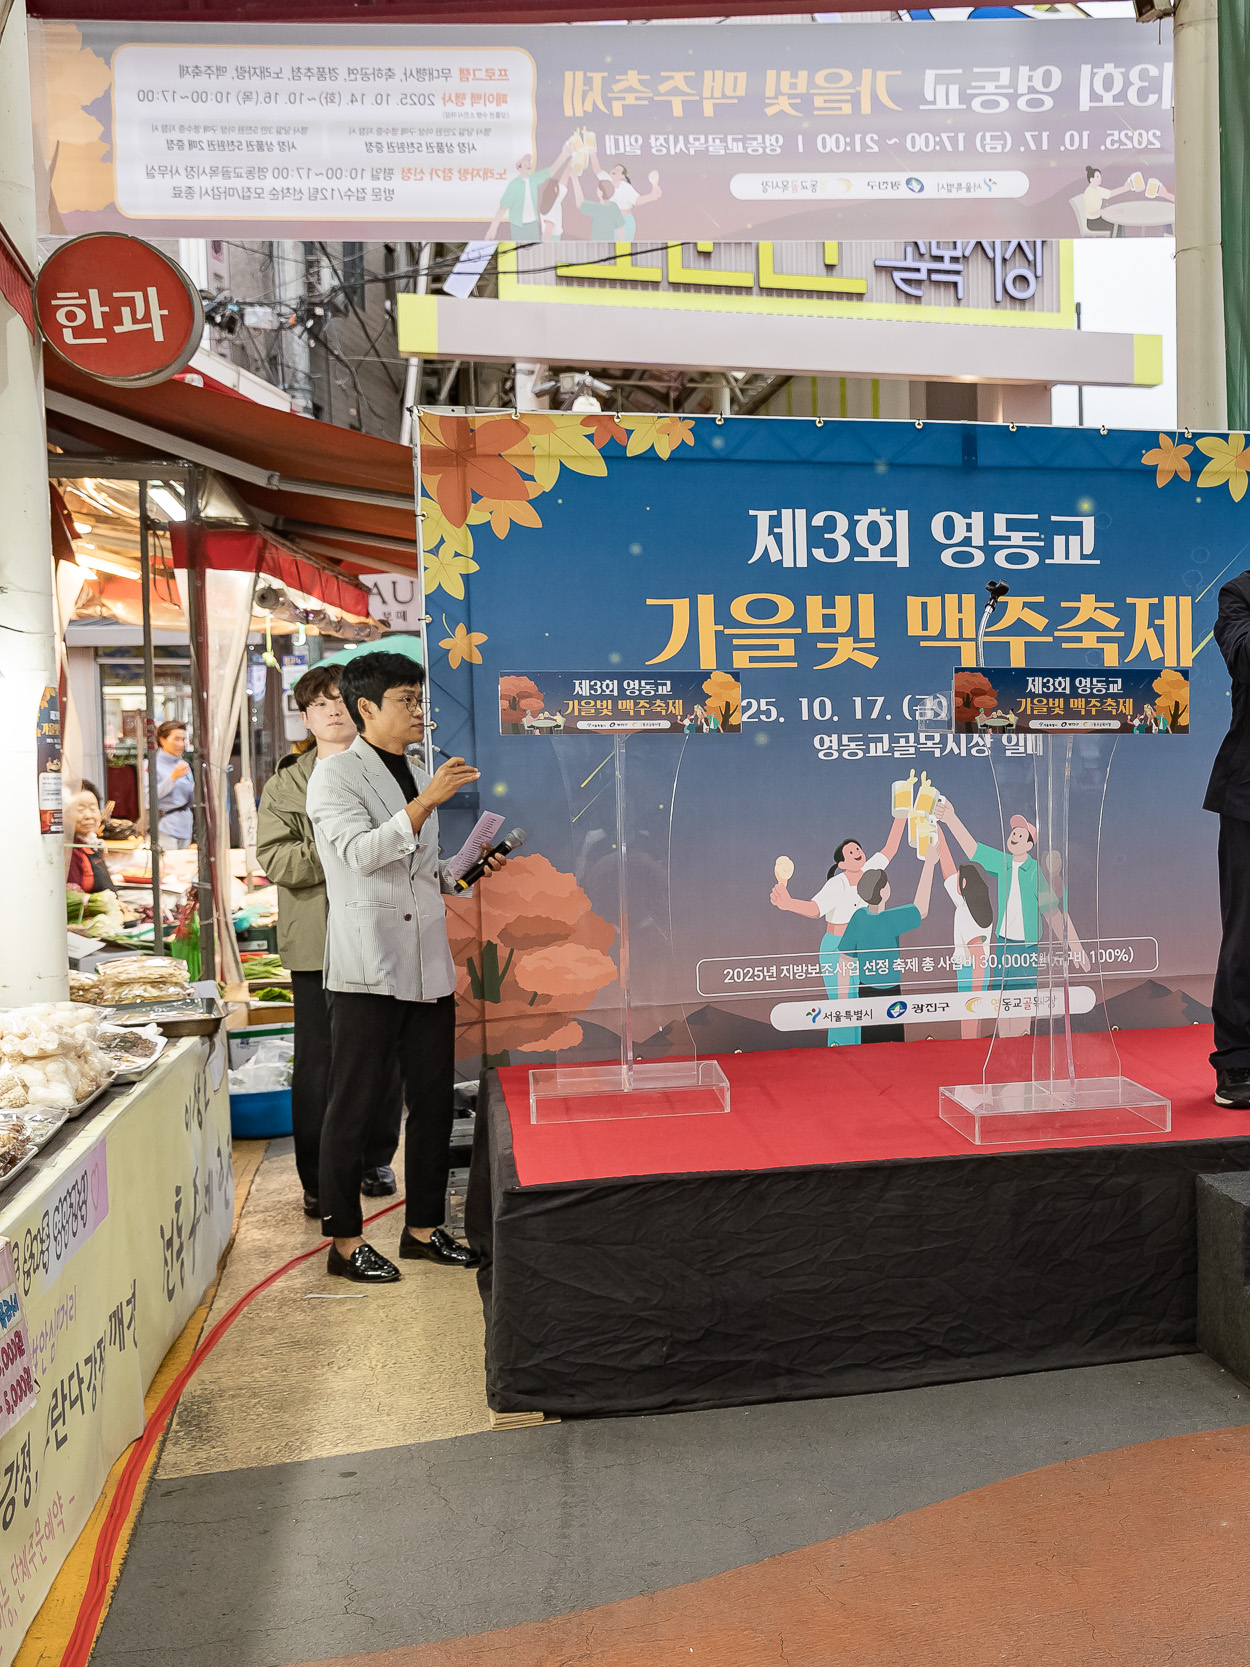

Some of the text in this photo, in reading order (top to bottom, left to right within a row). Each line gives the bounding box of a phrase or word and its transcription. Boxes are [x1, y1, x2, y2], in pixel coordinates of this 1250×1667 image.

[51, 285, 168, 345] 한과
[748, 508, 1101, 570] 제3회 영동교
[645, 592, 1194, 670] 가을빛 맥주축제
[572, 679, 673, 696] 제3회 영동교
[1026, 676, 1123, 695] 제3회 영동교
[563, 699, 683, 717] 가을빛 맥주축제
[799, 696, 839, 722] 10.
[853, 696, 892, 721] 17.
[1016, 698, 1133, 716] 가을빛 맥주축제
[723, 965, 777, 983] 2025년
[780, 960, 860, 980] 지방보조사업
[863, 959, 889, 976] 선정
[892, 957, 918, 974] 축제
[921, 956, 934, 972] 총
[939, 954, 976, 971] 사업비
[1090, 946, 1134, 964] 100%)
[823, 1009, 873, 1023] 서울특별시
[911, 1002, 951, 1015] 광진구
